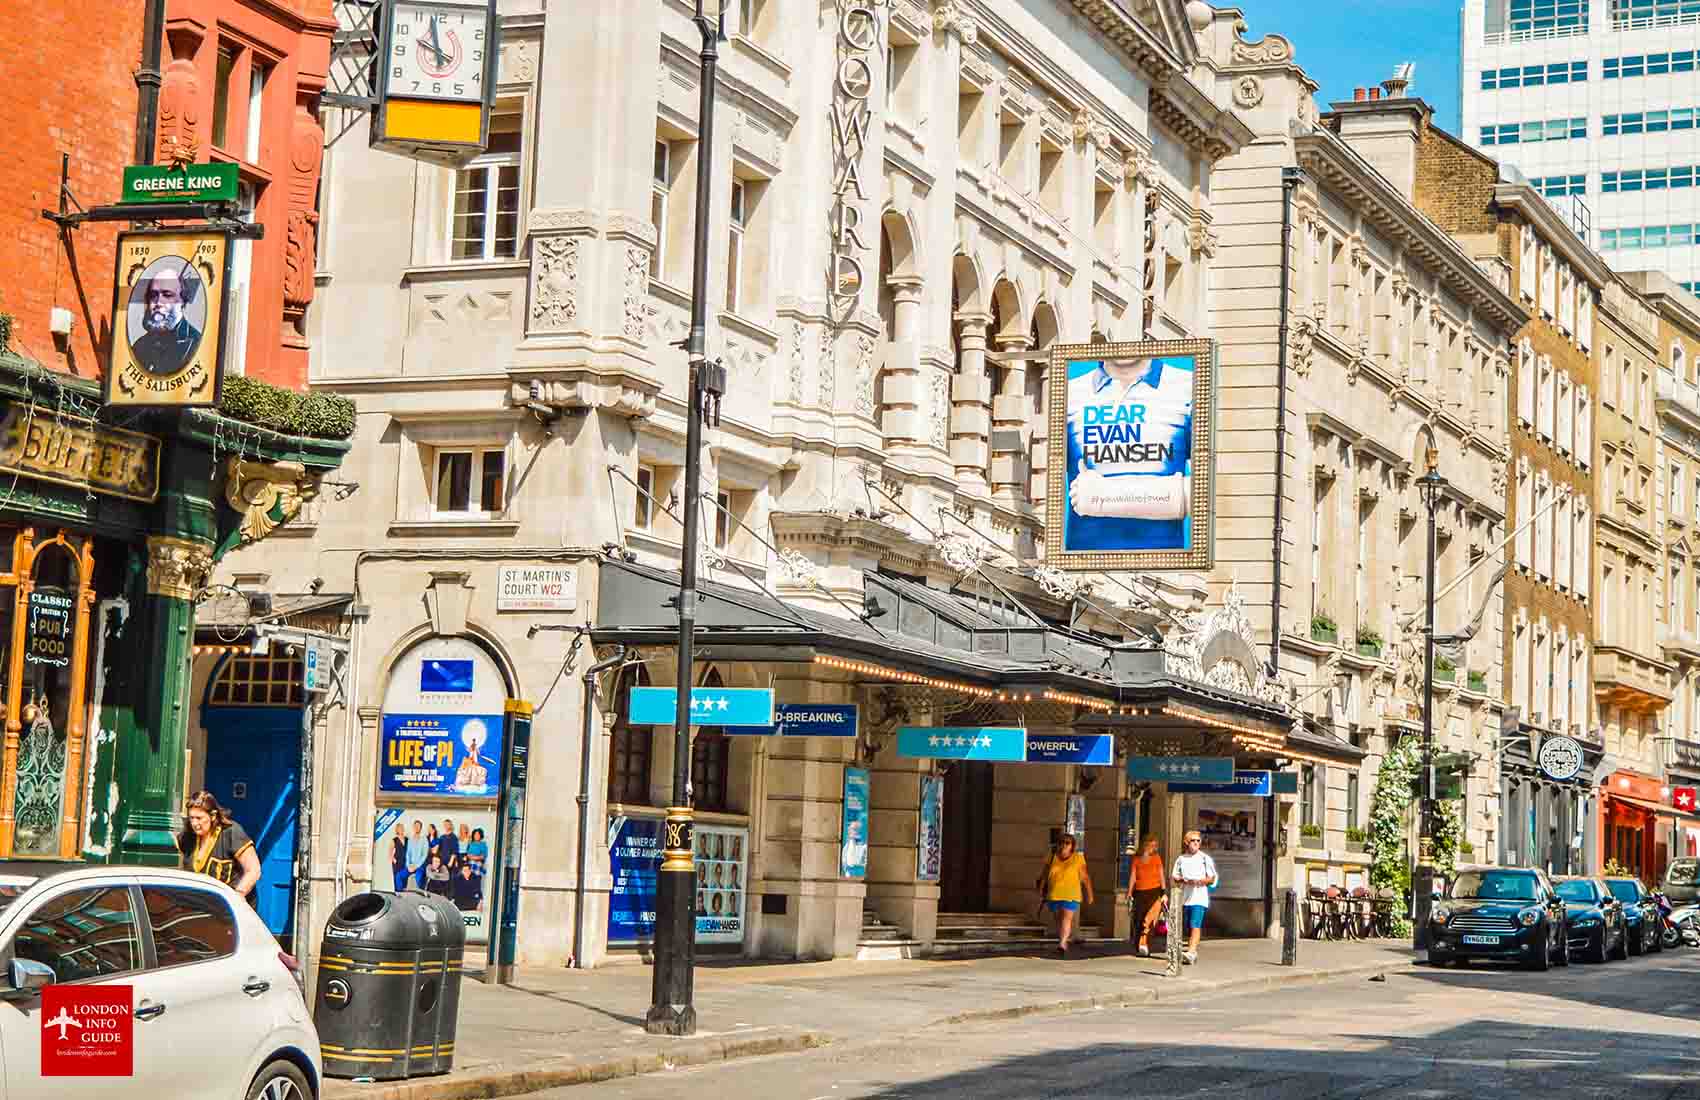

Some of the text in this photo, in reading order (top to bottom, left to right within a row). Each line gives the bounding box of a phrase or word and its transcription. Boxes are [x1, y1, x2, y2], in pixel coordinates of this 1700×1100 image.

[396, 24, 409, 35] 10
[473, 29, 484, 40] 2
[394, 45, 406, 56] 9
[472, 50, 482, 61] 3
[393, 67, 403, 78] 8
[472, 72, 481, 84] 4
[411, 81, 420, 91] 7
[432, 82, 441, 94] 6
[454, 83, 464, 95] 5
[830, 8, 877, 296] COWARD
[133, 176, 222, 191] GREENE KING
[130, 247, 150, 256] 1830
[125, 360, 203, 392] THE SALISBURY
[1083, 404, 1145, 424] DEAR
[1083, 424, 1141, 444] EVAN
[1083, 443, 1174, 465] HANSEN
[505, 570, 571, 582] ST MARTIN'S
[504, 583, 562, 595] COURT WC2
[31, 593, 72, 608] CLASSIC
[39, 618, 61, 634] PUB
[32, 637, 65, 654] FOOD
[388, 739, 453, 767] LIFE OF PI
